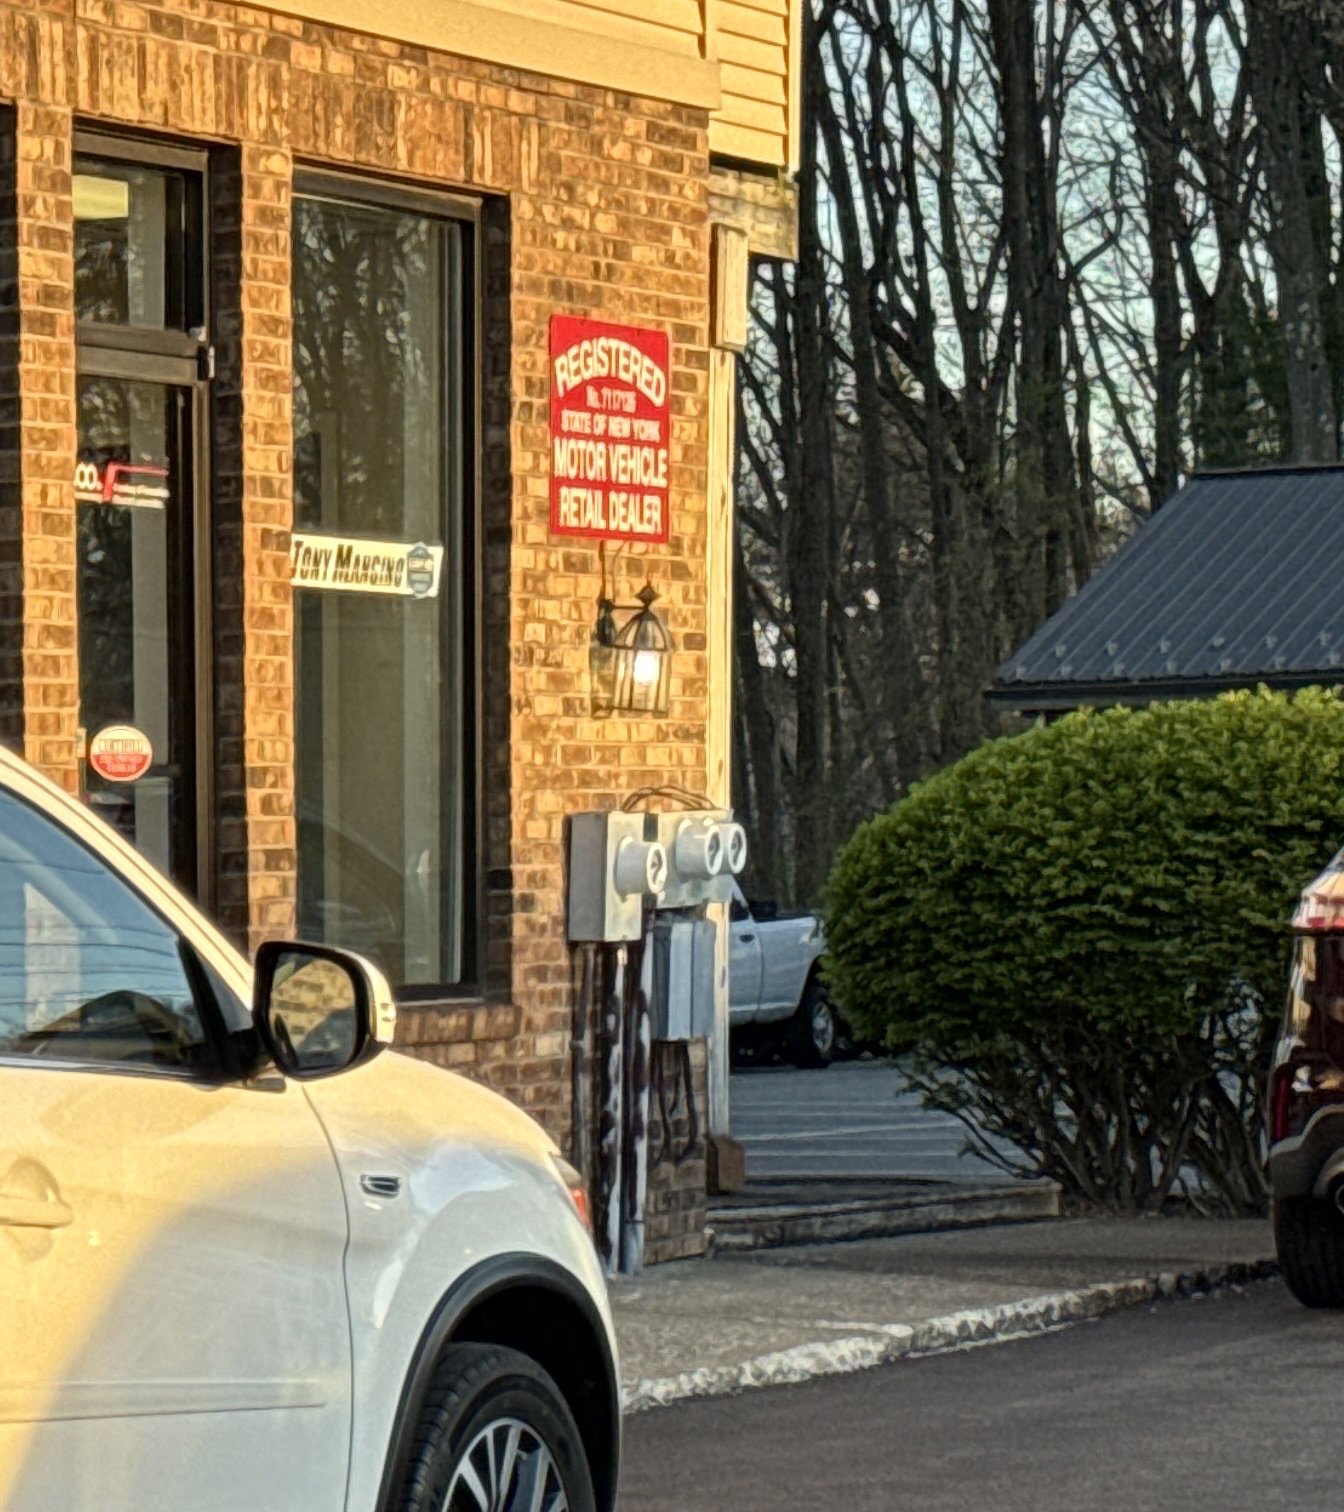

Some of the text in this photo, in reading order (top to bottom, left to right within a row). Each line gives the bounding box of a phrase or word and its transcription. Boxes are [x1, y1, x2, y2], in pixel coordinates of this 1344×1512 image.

[554, 337, 666, 407] REGISTERED
[561, 409, 661, 443] STATE OF NEW YORK
[554, 437, 668, 488] MOTOR VEHICLE
[559, 486, 663, 534] RETAIL DEALER
[291, 540, 333, 583] TONY
